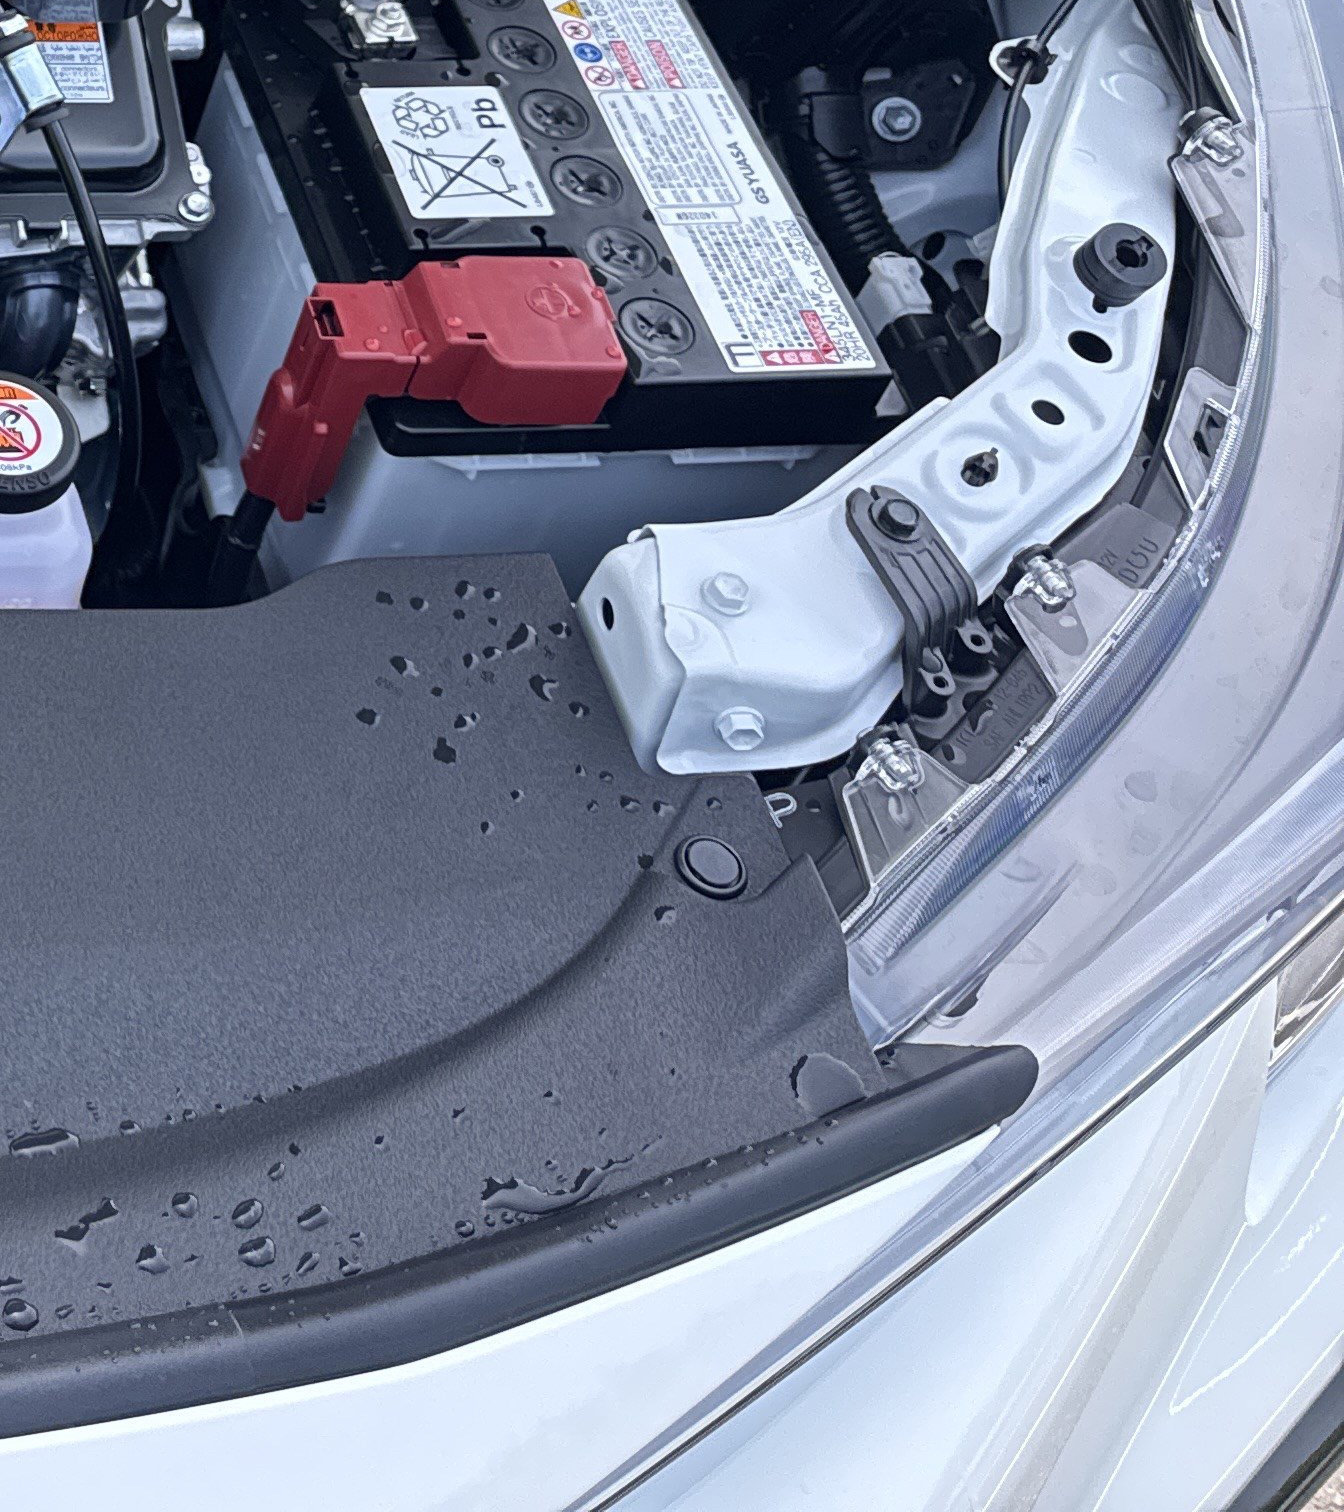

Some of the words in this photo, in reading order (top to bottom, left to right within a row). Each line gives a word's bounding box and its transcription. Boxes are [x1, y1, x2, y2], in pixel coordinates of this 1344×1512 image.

[471, 98, 506, 128] Pb
[723, 141, 761, 185] YUASA
[808, 269, 833, 293] CCA
[824, 299, 852, 327] 45Ah
[801, 311, 833, 348] DANGER
[841, 331, 870, 361] 20HR
[764, 792, 797, 828] P
